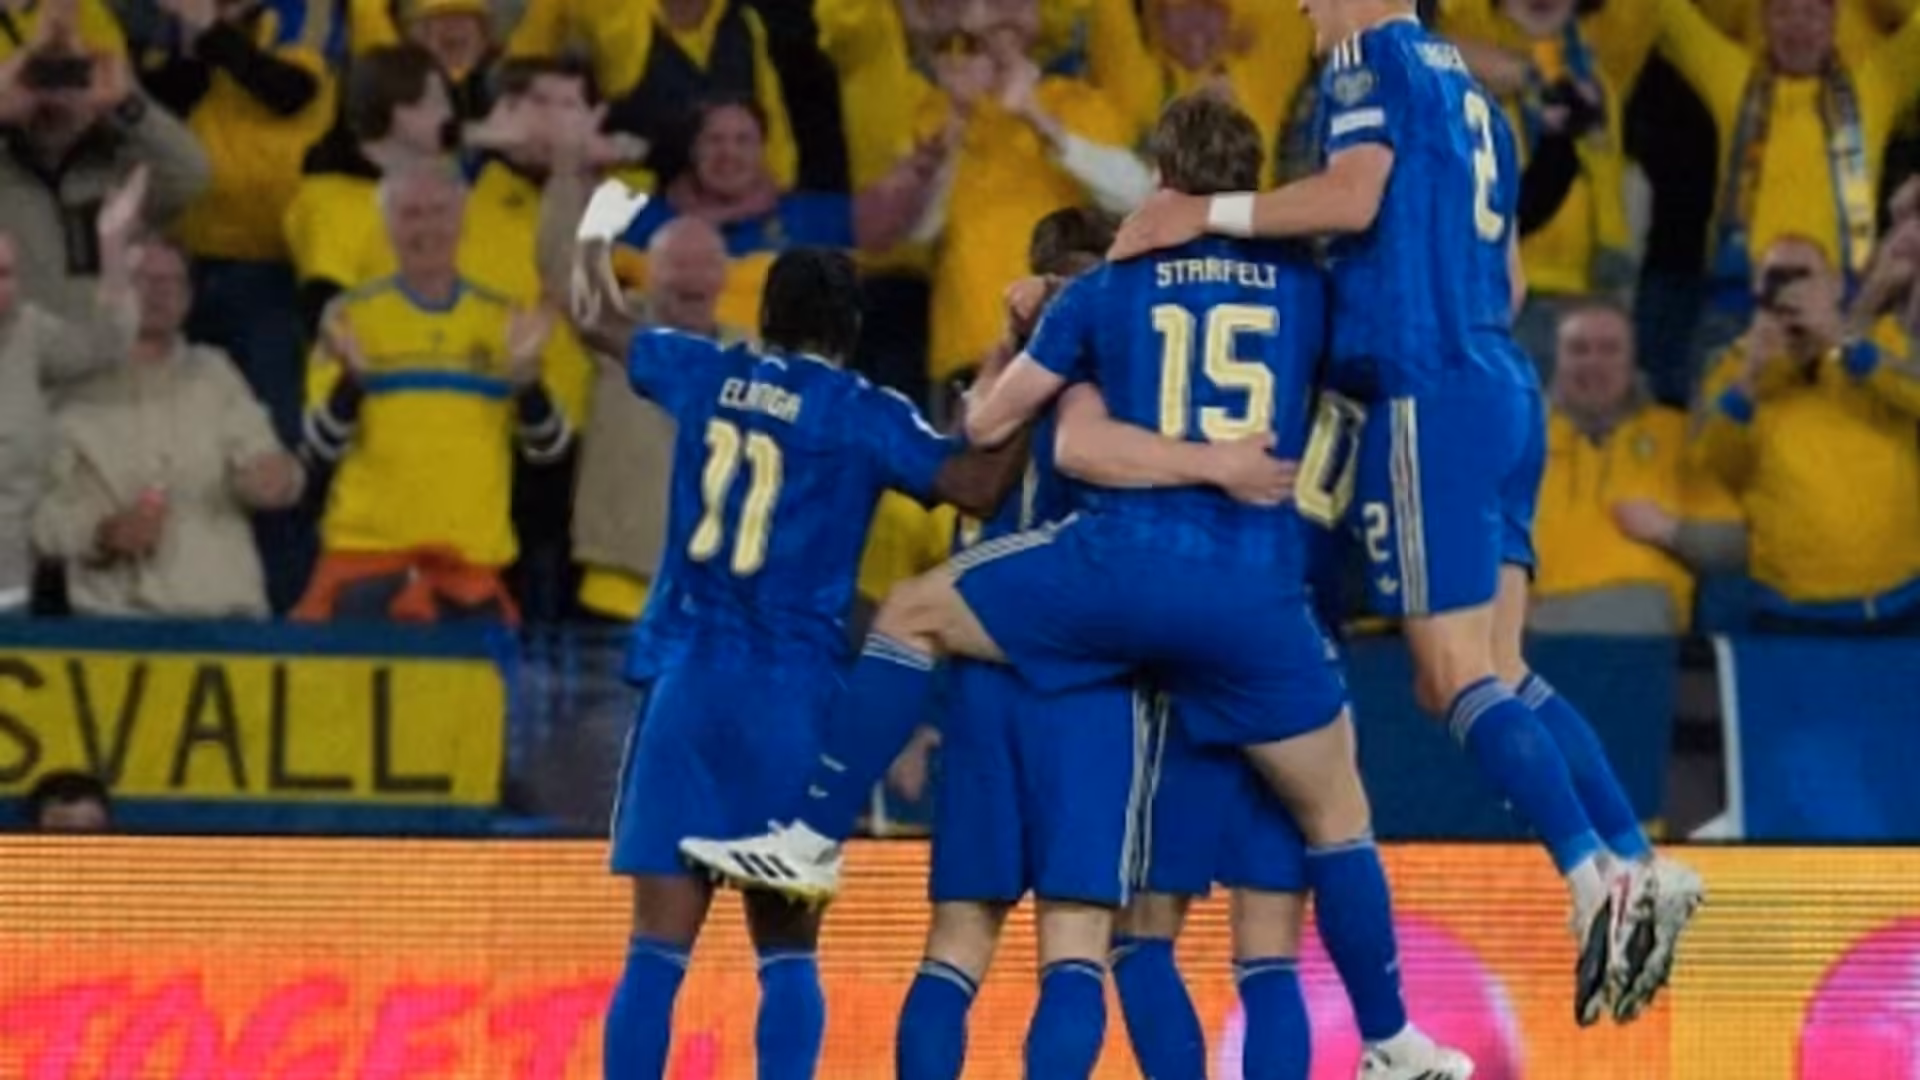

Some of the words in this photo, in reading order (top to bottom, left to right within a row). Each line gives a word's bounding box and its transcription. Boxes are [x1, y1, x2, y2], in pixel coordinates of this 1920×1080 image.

[1463, 89, 1505, 243] 2
[1151, 303, 1281, 441] 15
[686, 416, 784, 576] 11
[1362, 501, 1390, 563] 2
[0, 656, 453, 793] SVALL
[0, 970, 722, 1080] TOGET
